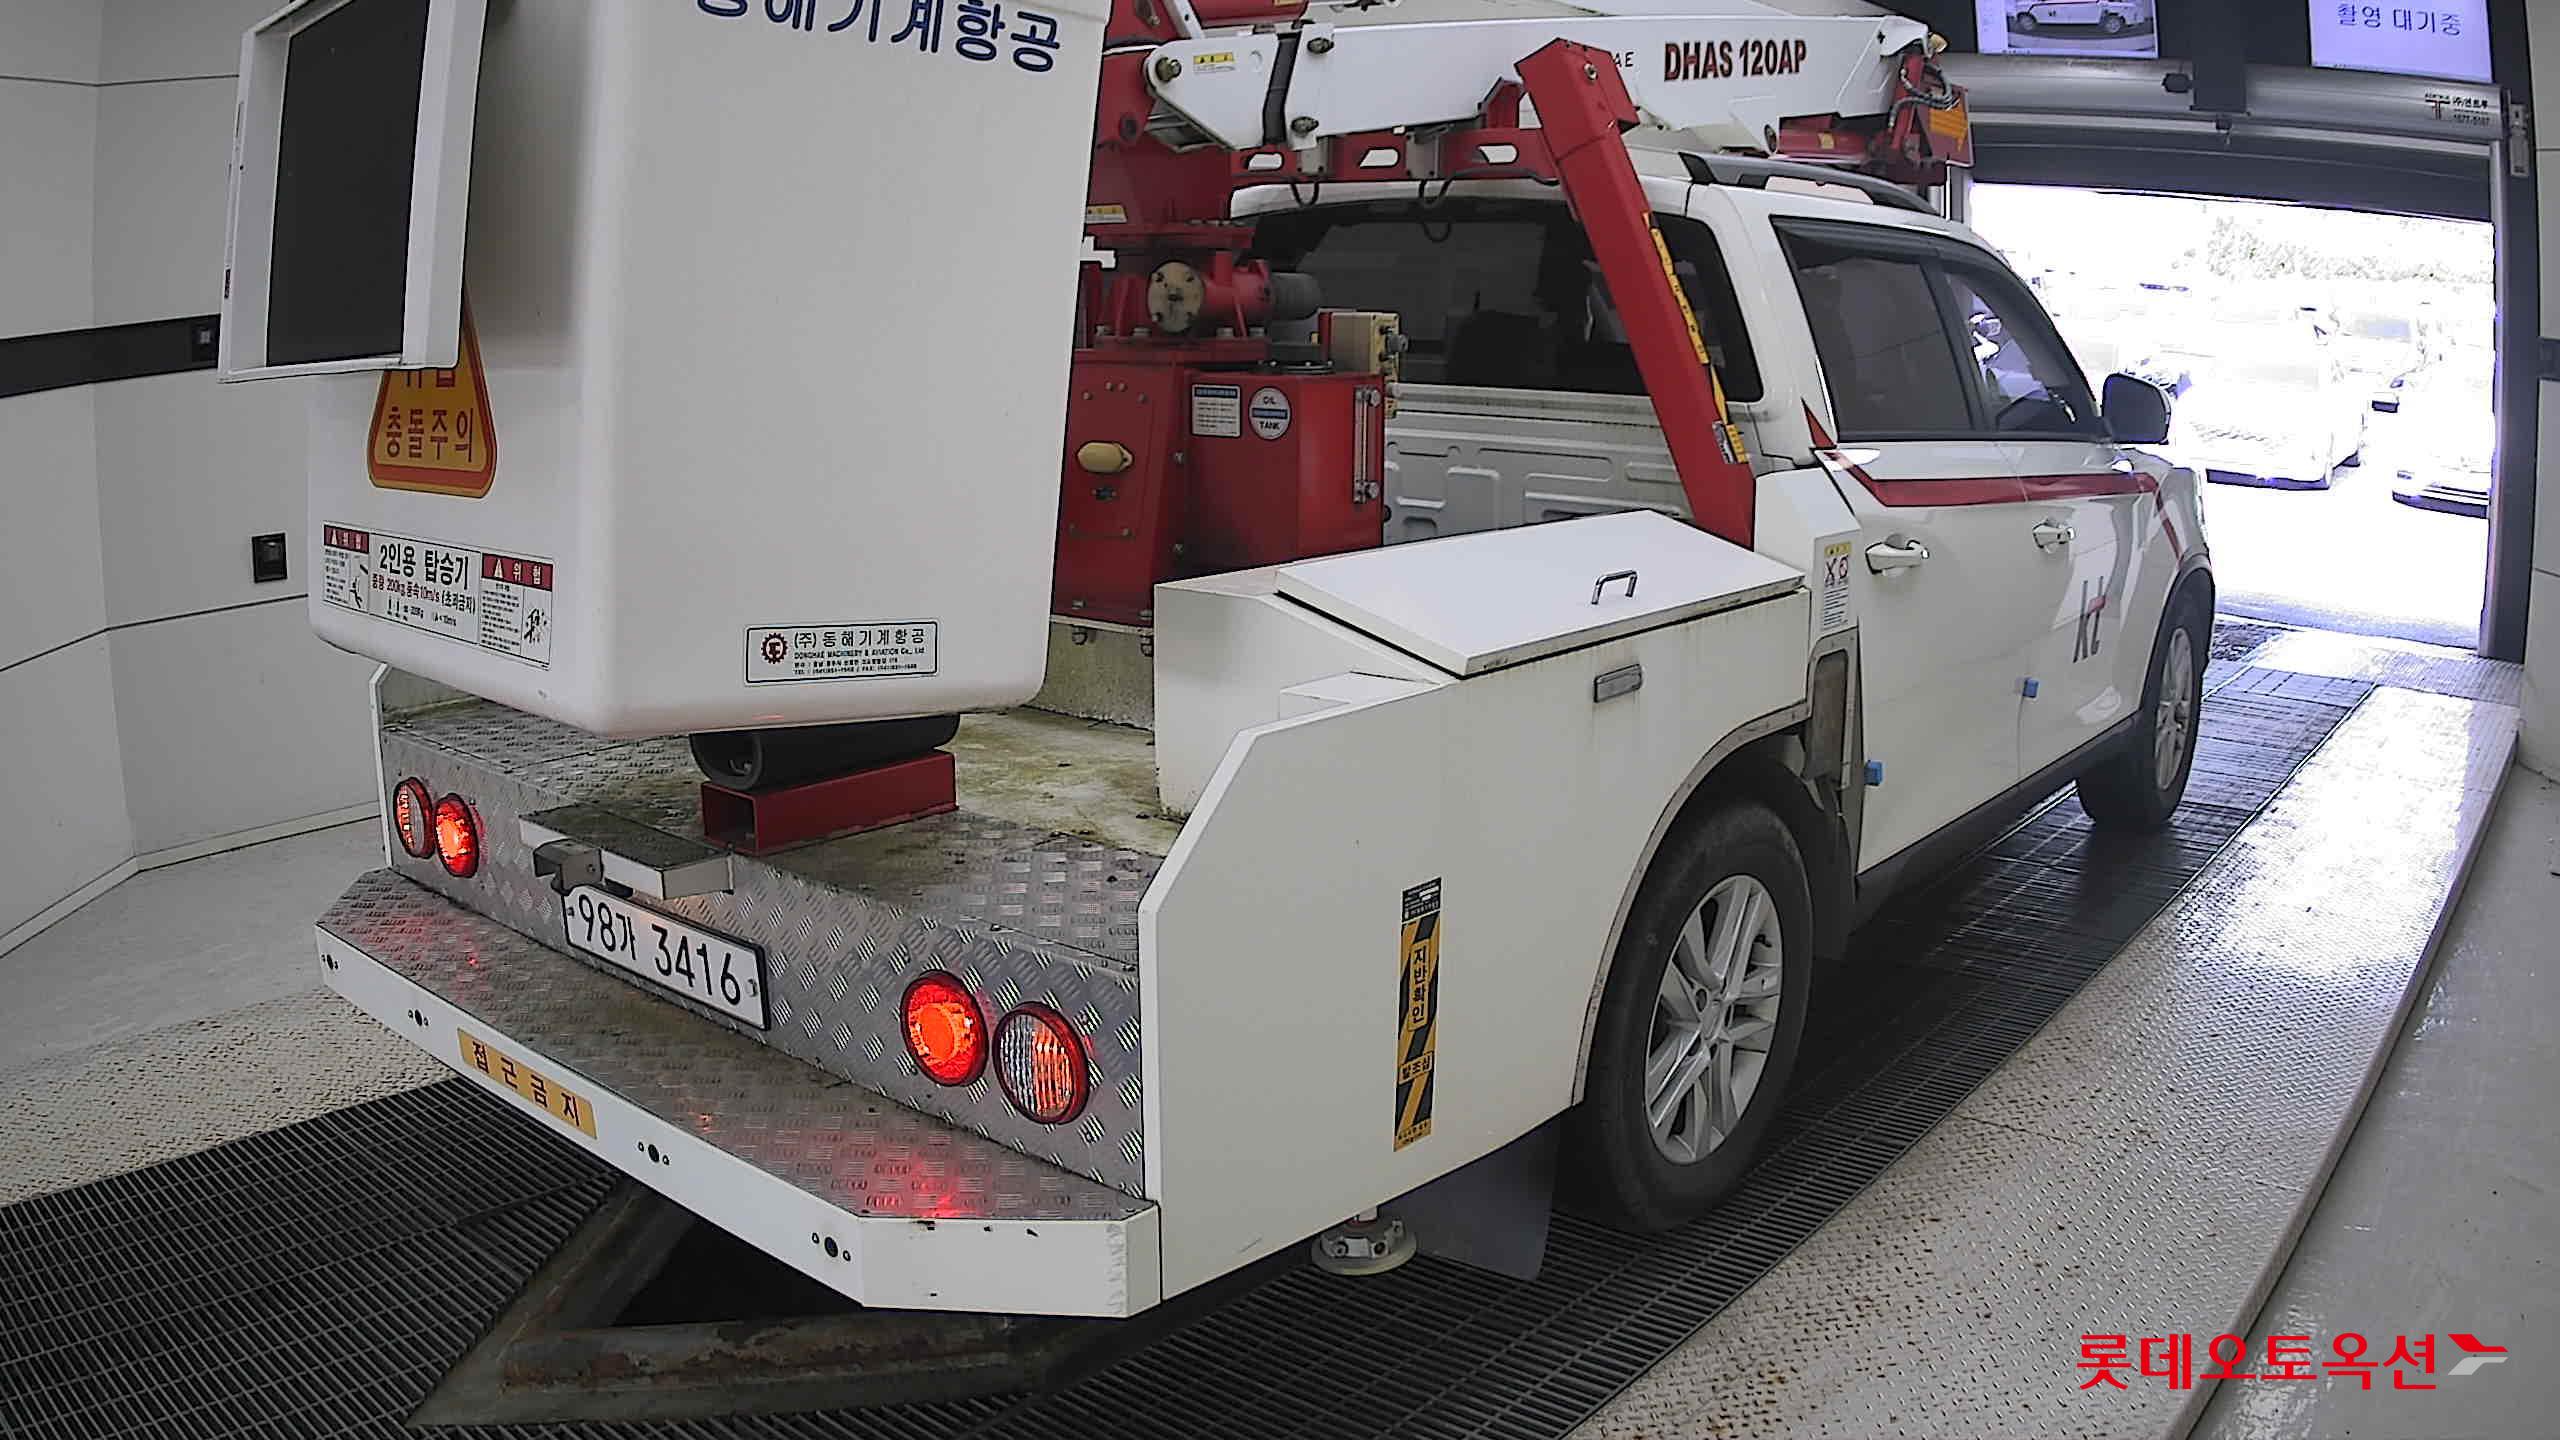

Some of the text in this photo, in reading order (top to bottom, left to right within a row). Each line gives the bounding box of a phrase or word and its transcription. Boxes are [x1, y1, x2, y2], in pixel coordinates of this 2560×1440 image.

[697, 0, 1061, 72] 기계항공
[2337, 3, 2460, 36] 촬영 대기중
[1664, 39, 1807, 82] DHAS 120AP
[386, 406, 474, 462] 충돌주의
[380, 543, 416, 578] 2인용
[425, 549, 469, 590] 탑승기
[794, 629, 925, 648] (주) 동해기계항공
[578, 894, 742, 1006] 98가 3416
[472, 1041, 580, 1127] 접근금지
